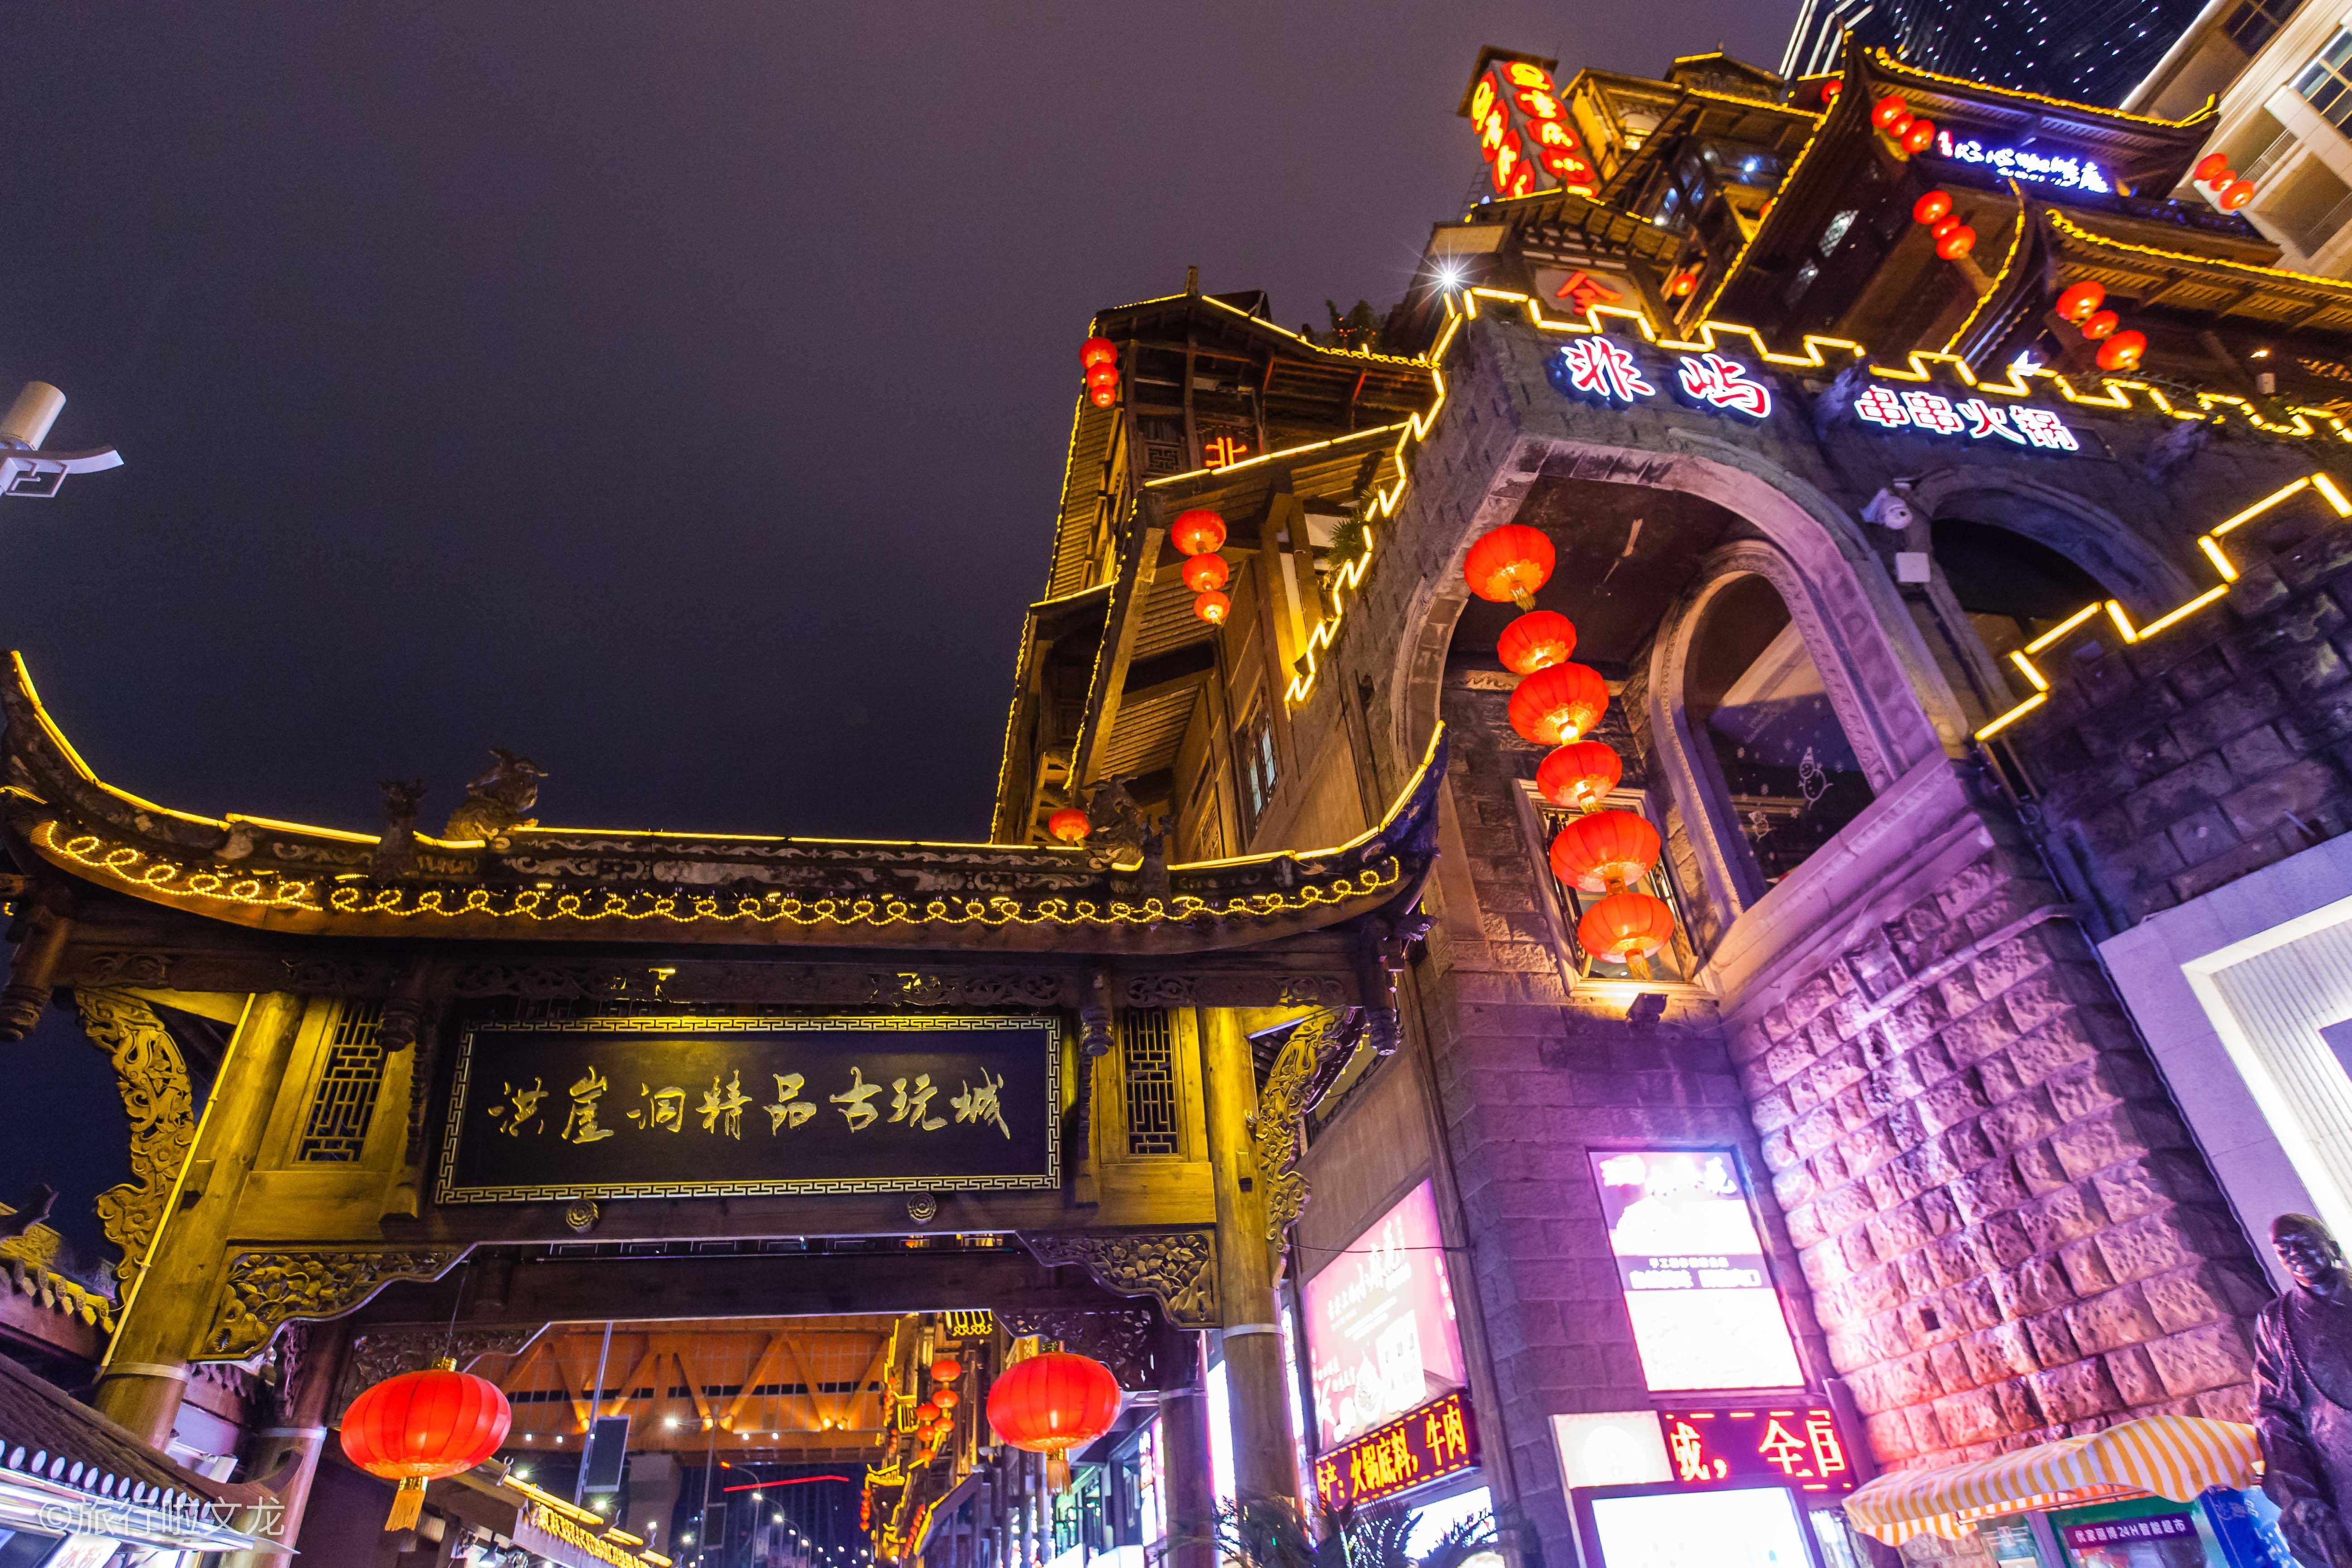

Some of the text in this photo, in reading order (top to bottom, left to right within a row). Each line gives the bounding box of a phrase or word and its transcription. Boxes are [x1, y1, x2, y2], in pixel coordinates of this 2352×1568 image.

[1854, 385, 2080, 450] 串串火锅
[488, 1066, 1011, 1144] 洪崖洞精品古玩城
